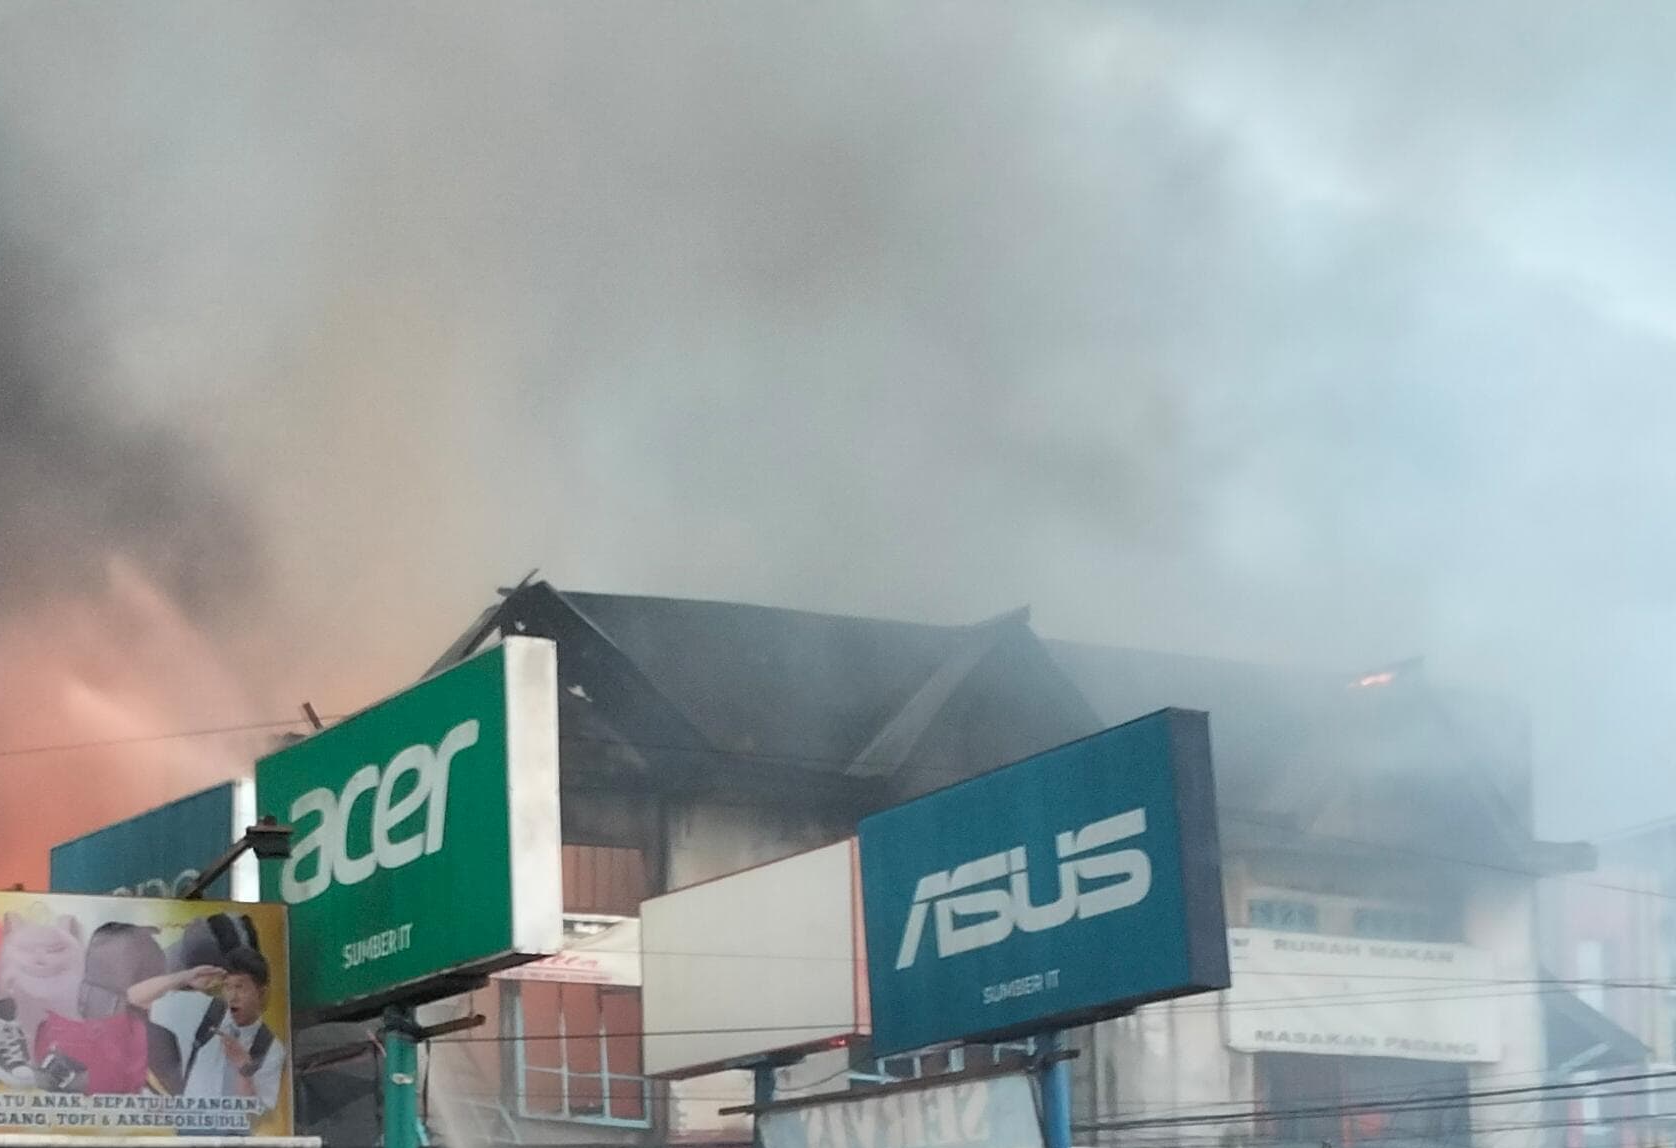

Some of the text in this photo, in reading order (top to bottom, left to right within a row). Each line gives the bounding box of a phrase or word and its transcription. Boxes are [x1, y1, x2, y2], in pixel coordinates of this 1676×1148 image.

[279, 719, 480, 904] acer
[894, 807, 1152, 970] ASUS
[341, 928, 398, 970] SUMBER
[983, 973, 1044, 1005] SUMBER
[56, 1112, 96, 1126] TOPI
[116, 1113, 214, 1128] AKSESORIS
[92, 1096, 160, 1111] SEPATU
